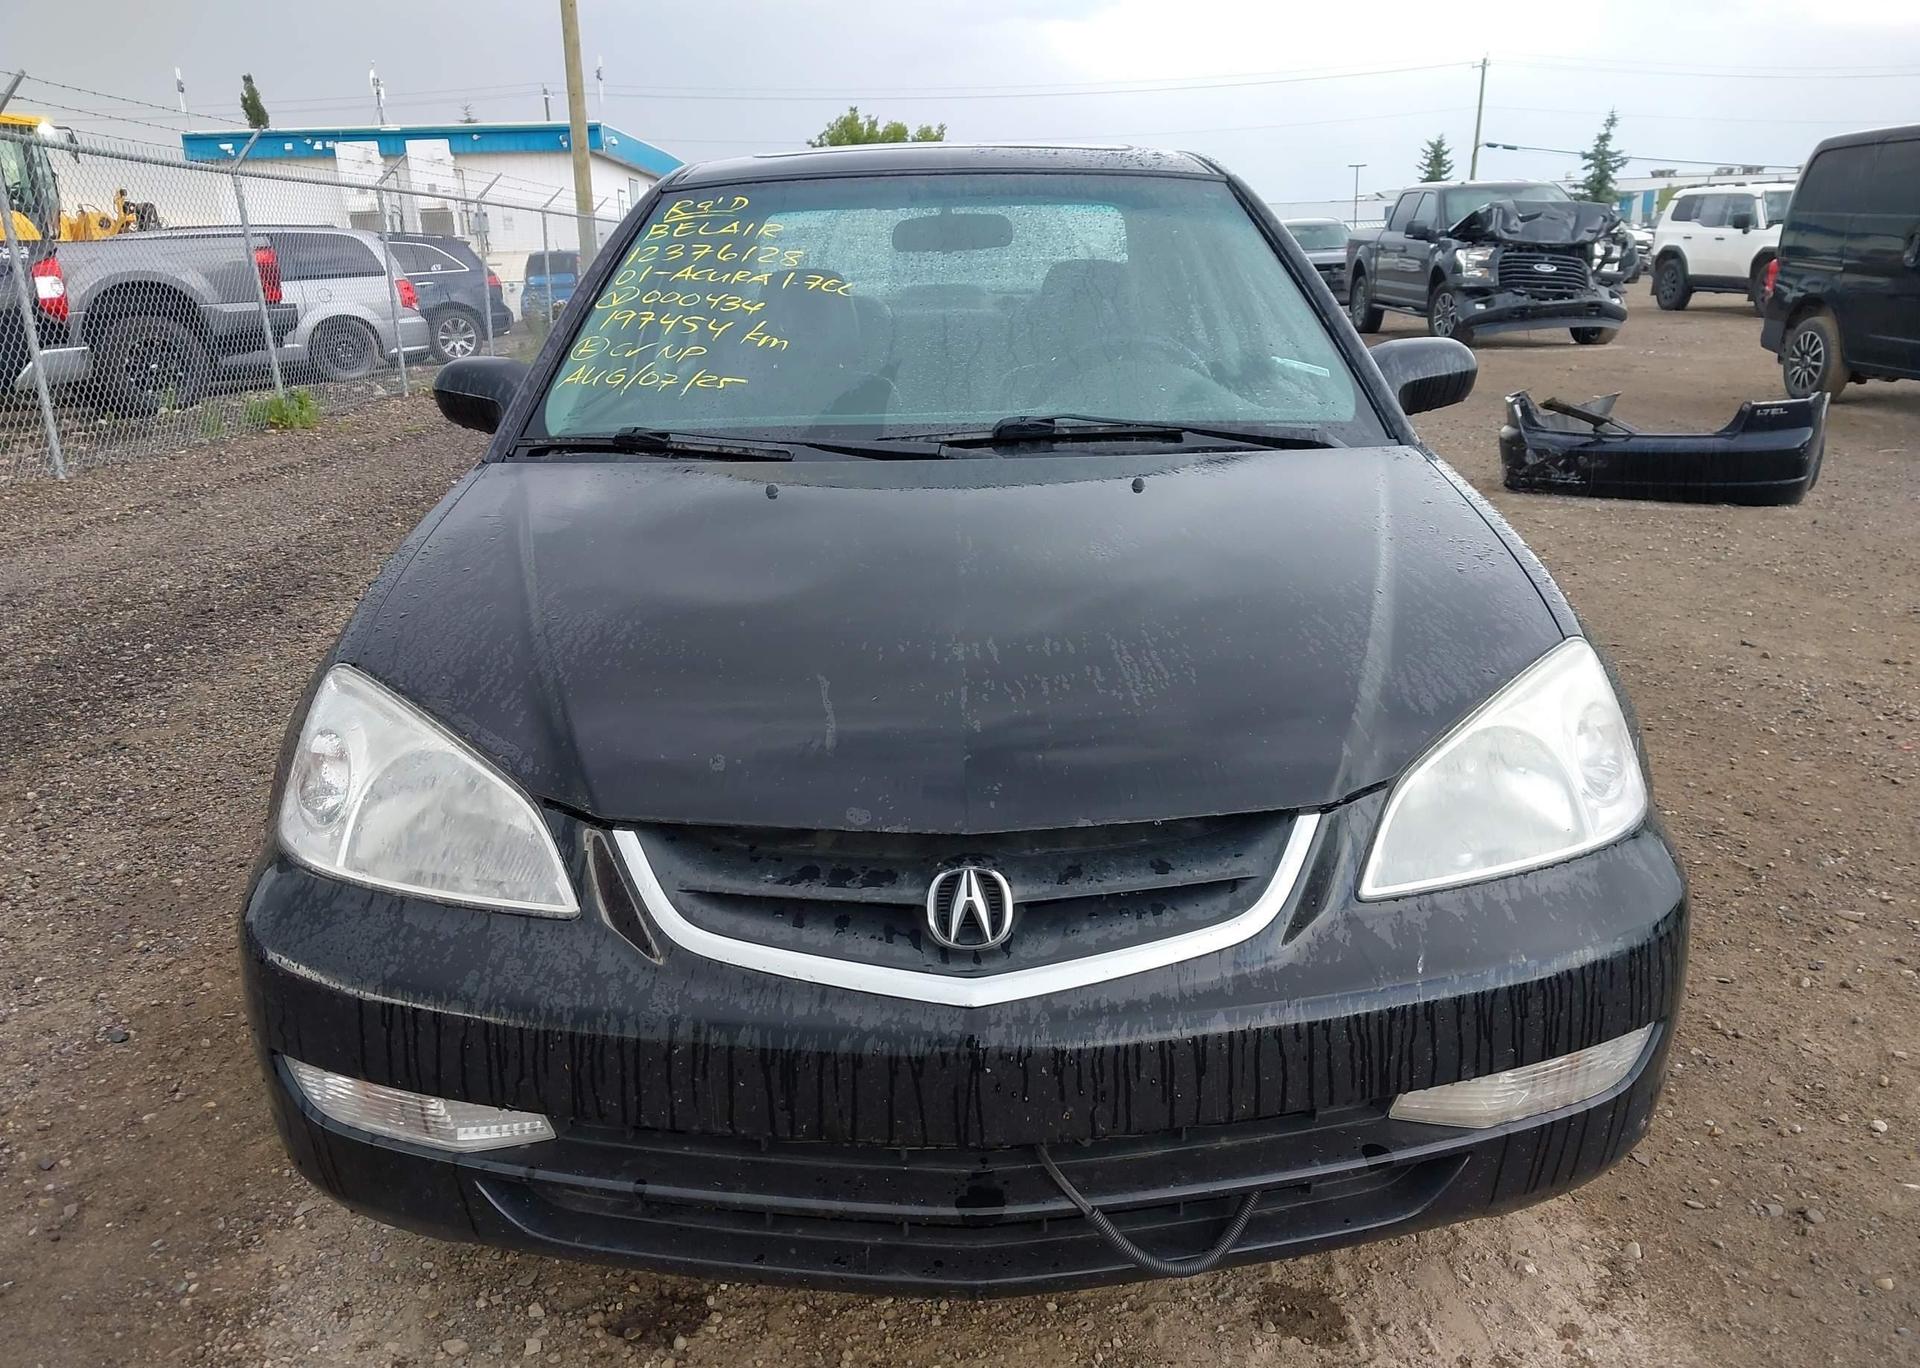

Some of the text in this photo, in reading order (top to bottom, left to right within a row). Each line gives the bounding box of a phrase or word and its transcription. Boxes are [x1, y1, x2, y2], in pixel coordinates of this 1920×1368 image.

[643, 221, 784, 242] BELAIR
[625, 243, 803, 266] 12376128
[600, 310, 734, 341] 197454
